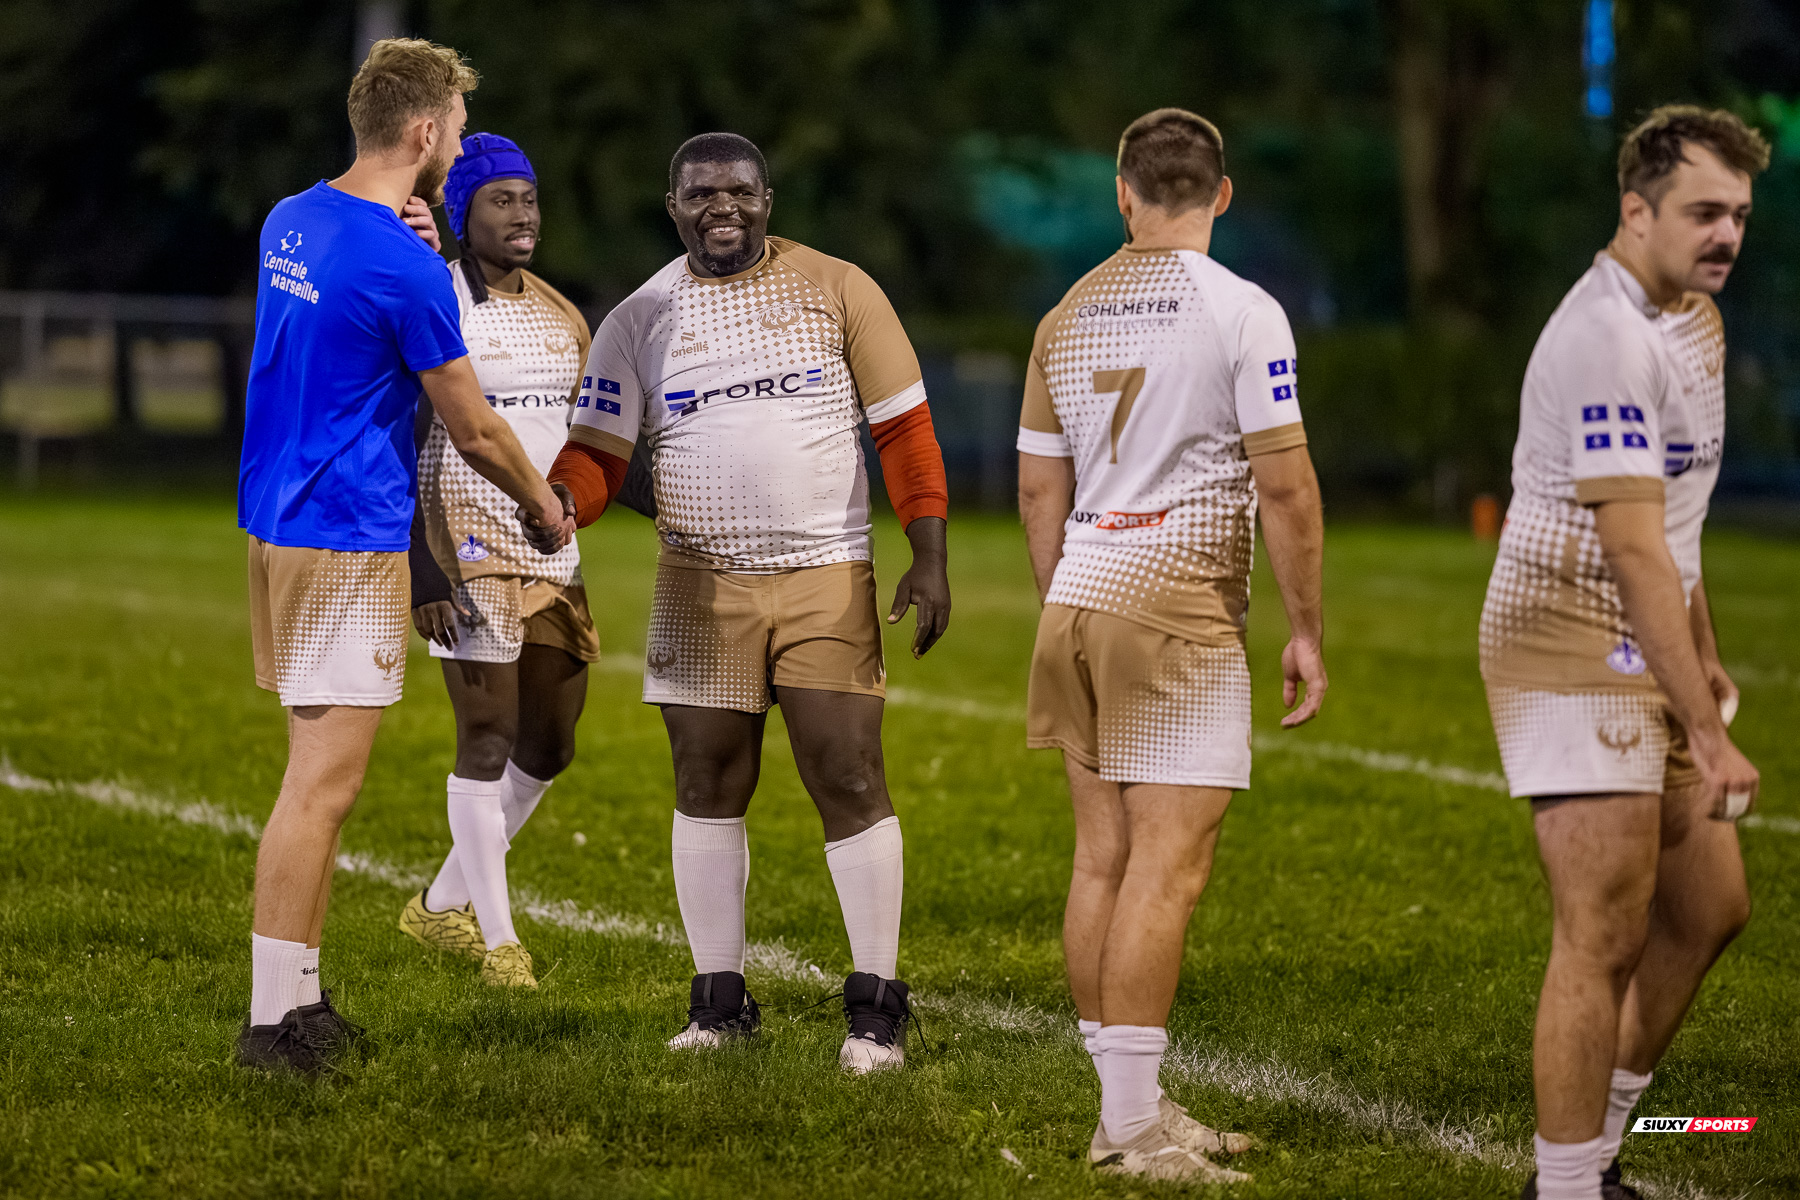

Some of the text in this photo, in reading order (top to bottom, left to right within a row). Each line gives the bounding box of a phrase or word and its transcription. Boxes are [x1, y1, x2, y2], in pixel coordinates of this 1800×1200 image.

[263, 250, 308, 280] Centrale
[270, 272, 320, 304] Marseille
[1078, 300, 1180, 318] COHLMEYER
[480, 350, 512, 362] oneills
[671, 342, 709, 358] oneills
[1092, 367, 1146, 464] 7
